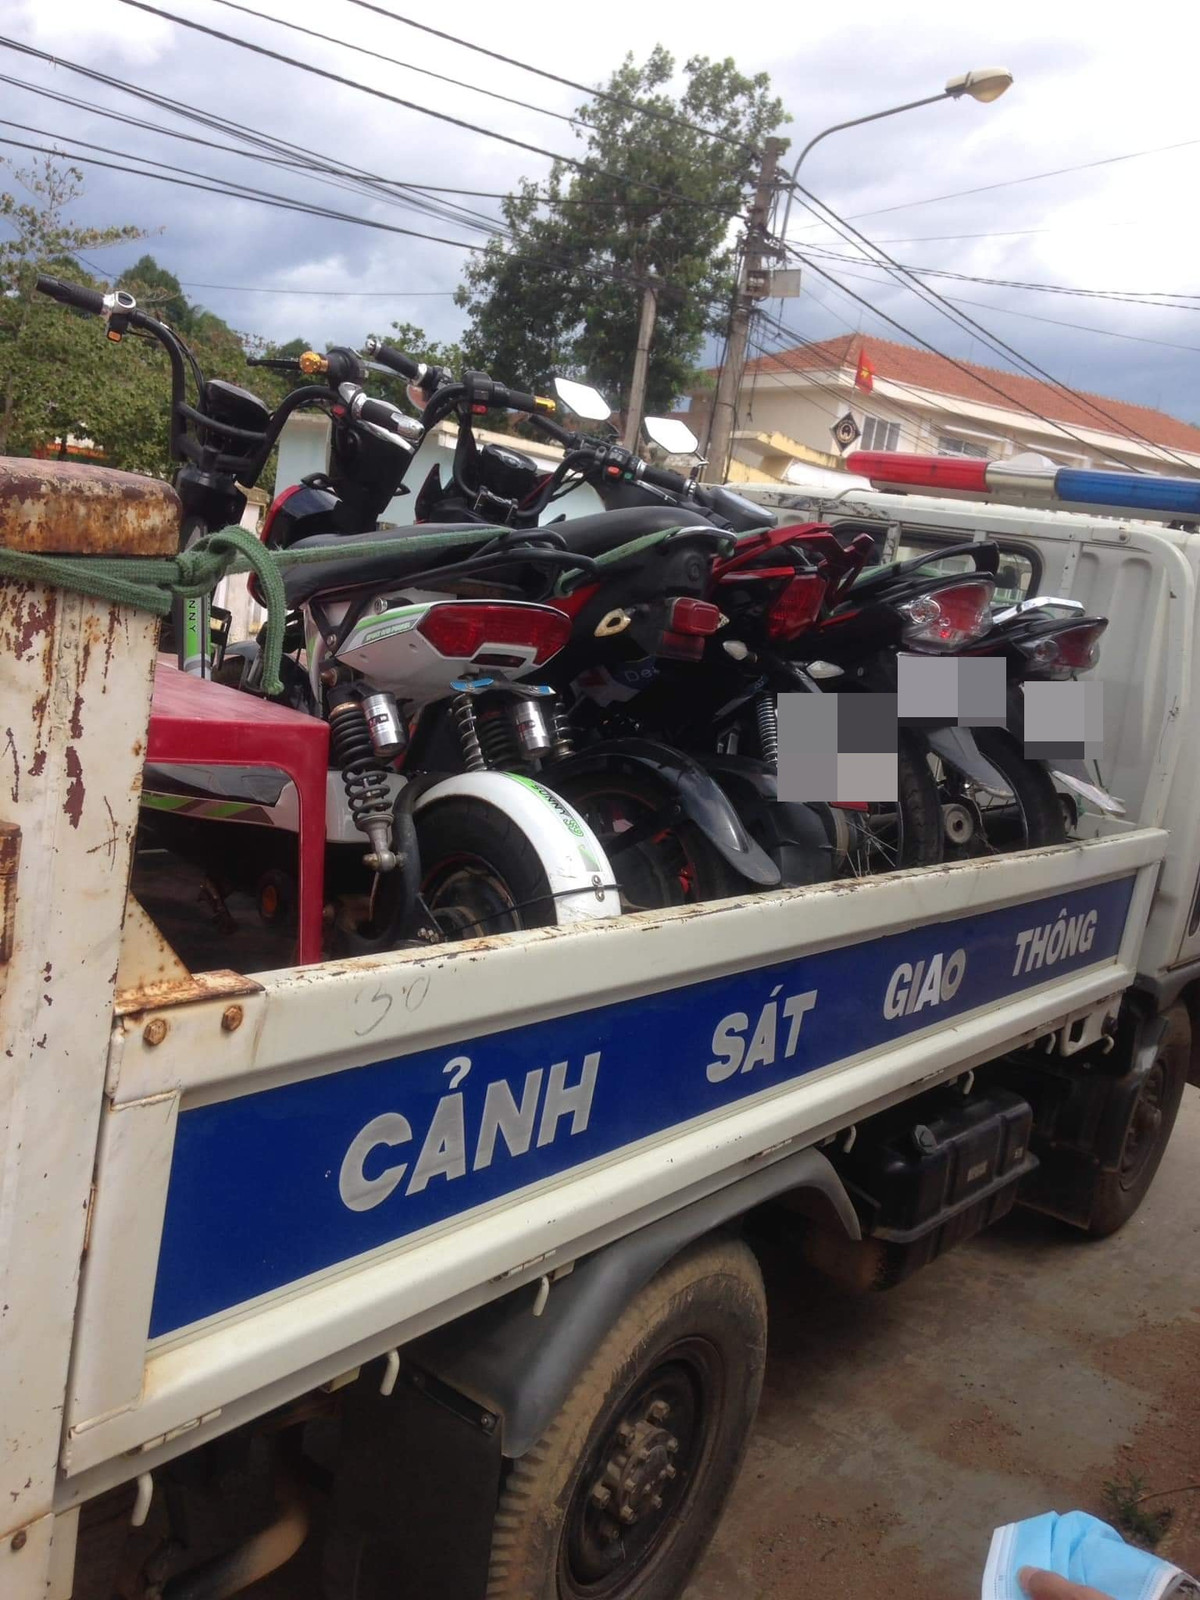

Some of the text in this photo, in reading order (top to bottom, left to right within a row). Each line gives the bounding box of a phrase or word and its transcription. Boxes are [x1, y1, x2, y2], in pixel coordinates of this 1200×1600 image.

[188, 600, 197, 633] NNY
[338, 908, 1098, 1212] CẢNH SÁT GIAO THÔNG
